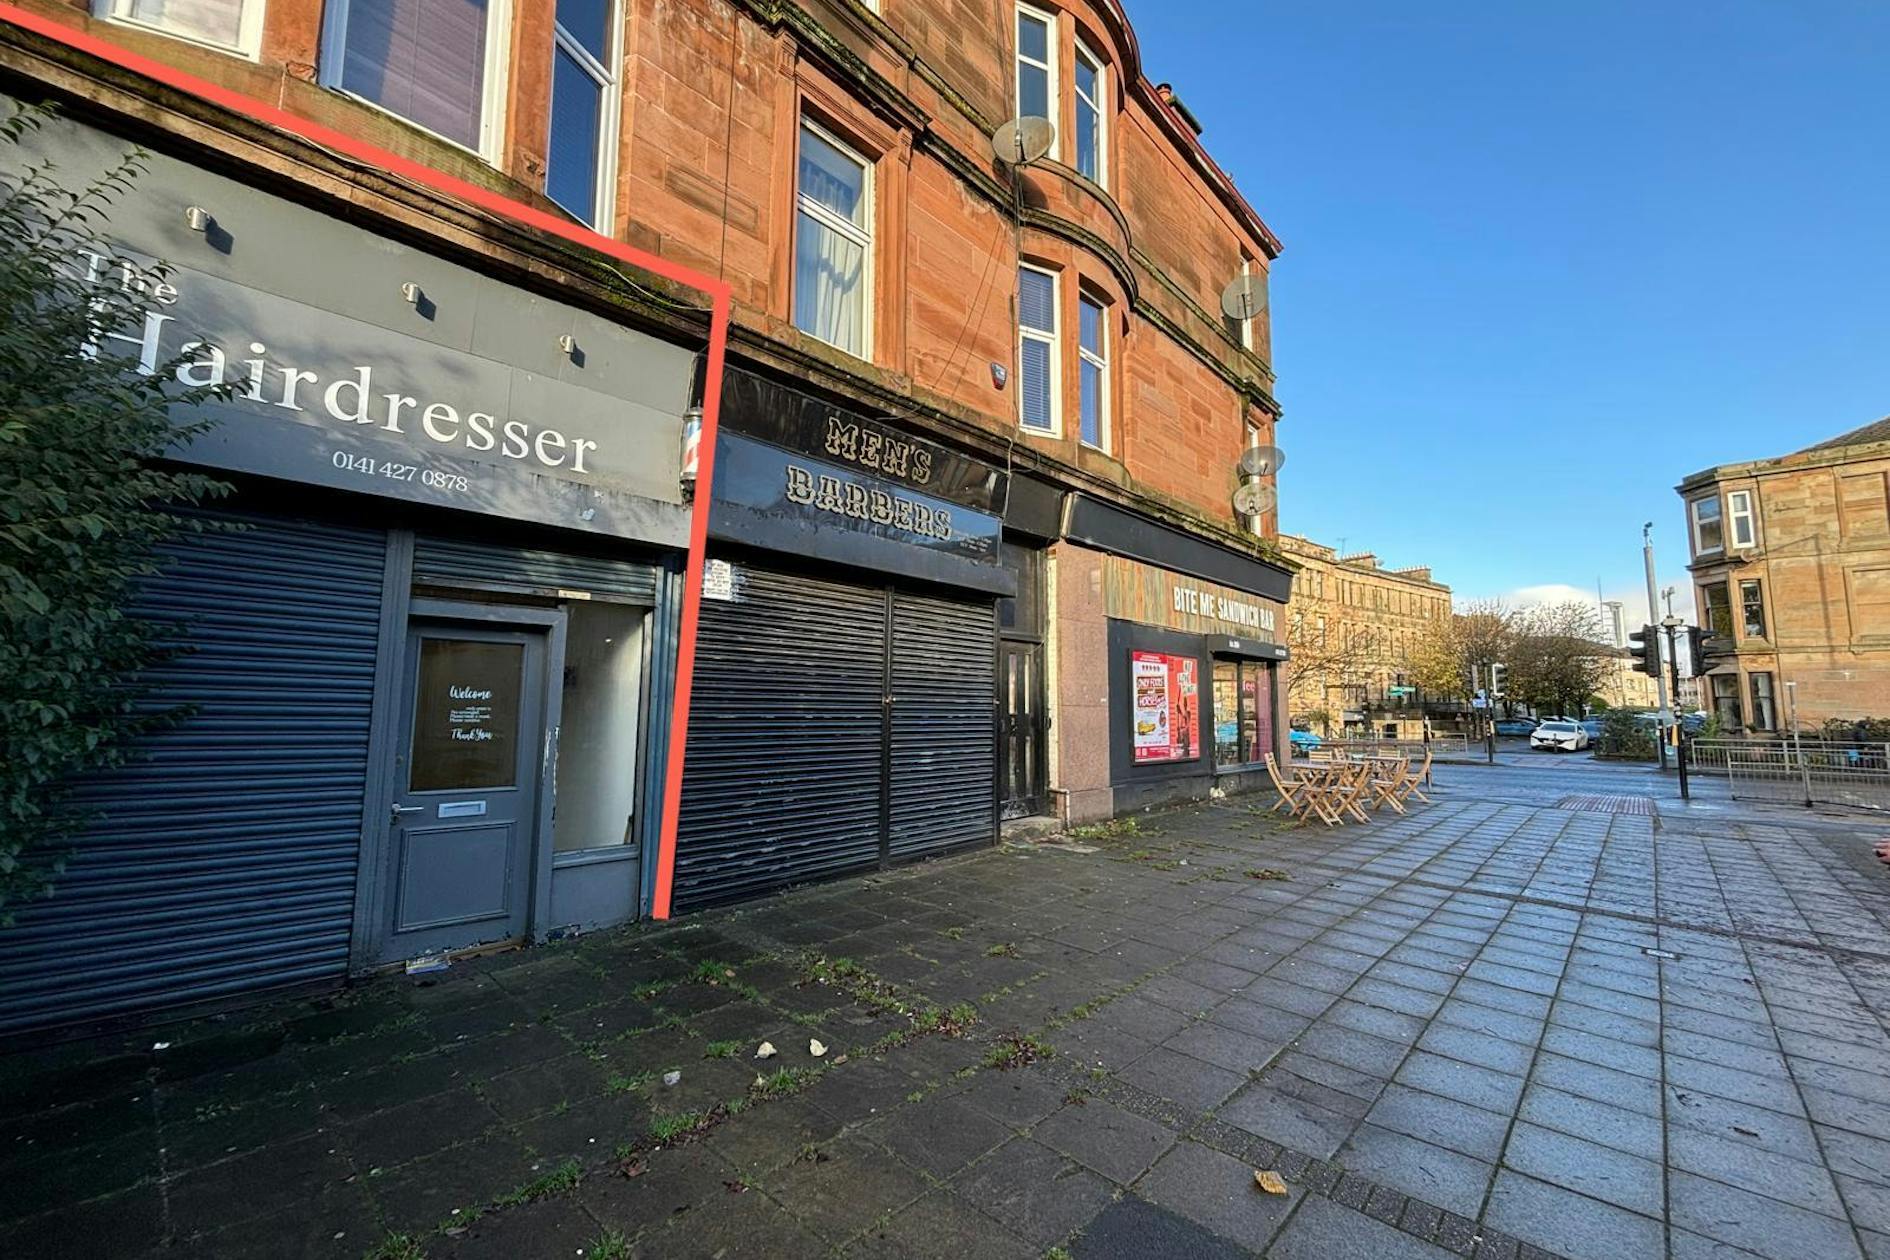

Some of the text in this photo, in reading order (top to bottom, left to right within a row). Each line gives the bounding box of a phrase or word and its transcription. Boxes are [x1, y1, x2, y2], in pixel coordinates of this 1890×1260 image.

[78, 250, 179, 305] The
[67, 297, 597, 474] Hairdresser
[332, 451, 468, 492] 0141 427 0878
[825, 416, 931, 484] MEN'S
[785, 464, 952, 540] BARBERS
[1174, 586, 1275, 632] BITE ME SANDWICH BAR
[450, 685, 493, 700] Welcome
[451, 728, 493, 741] Thank You
